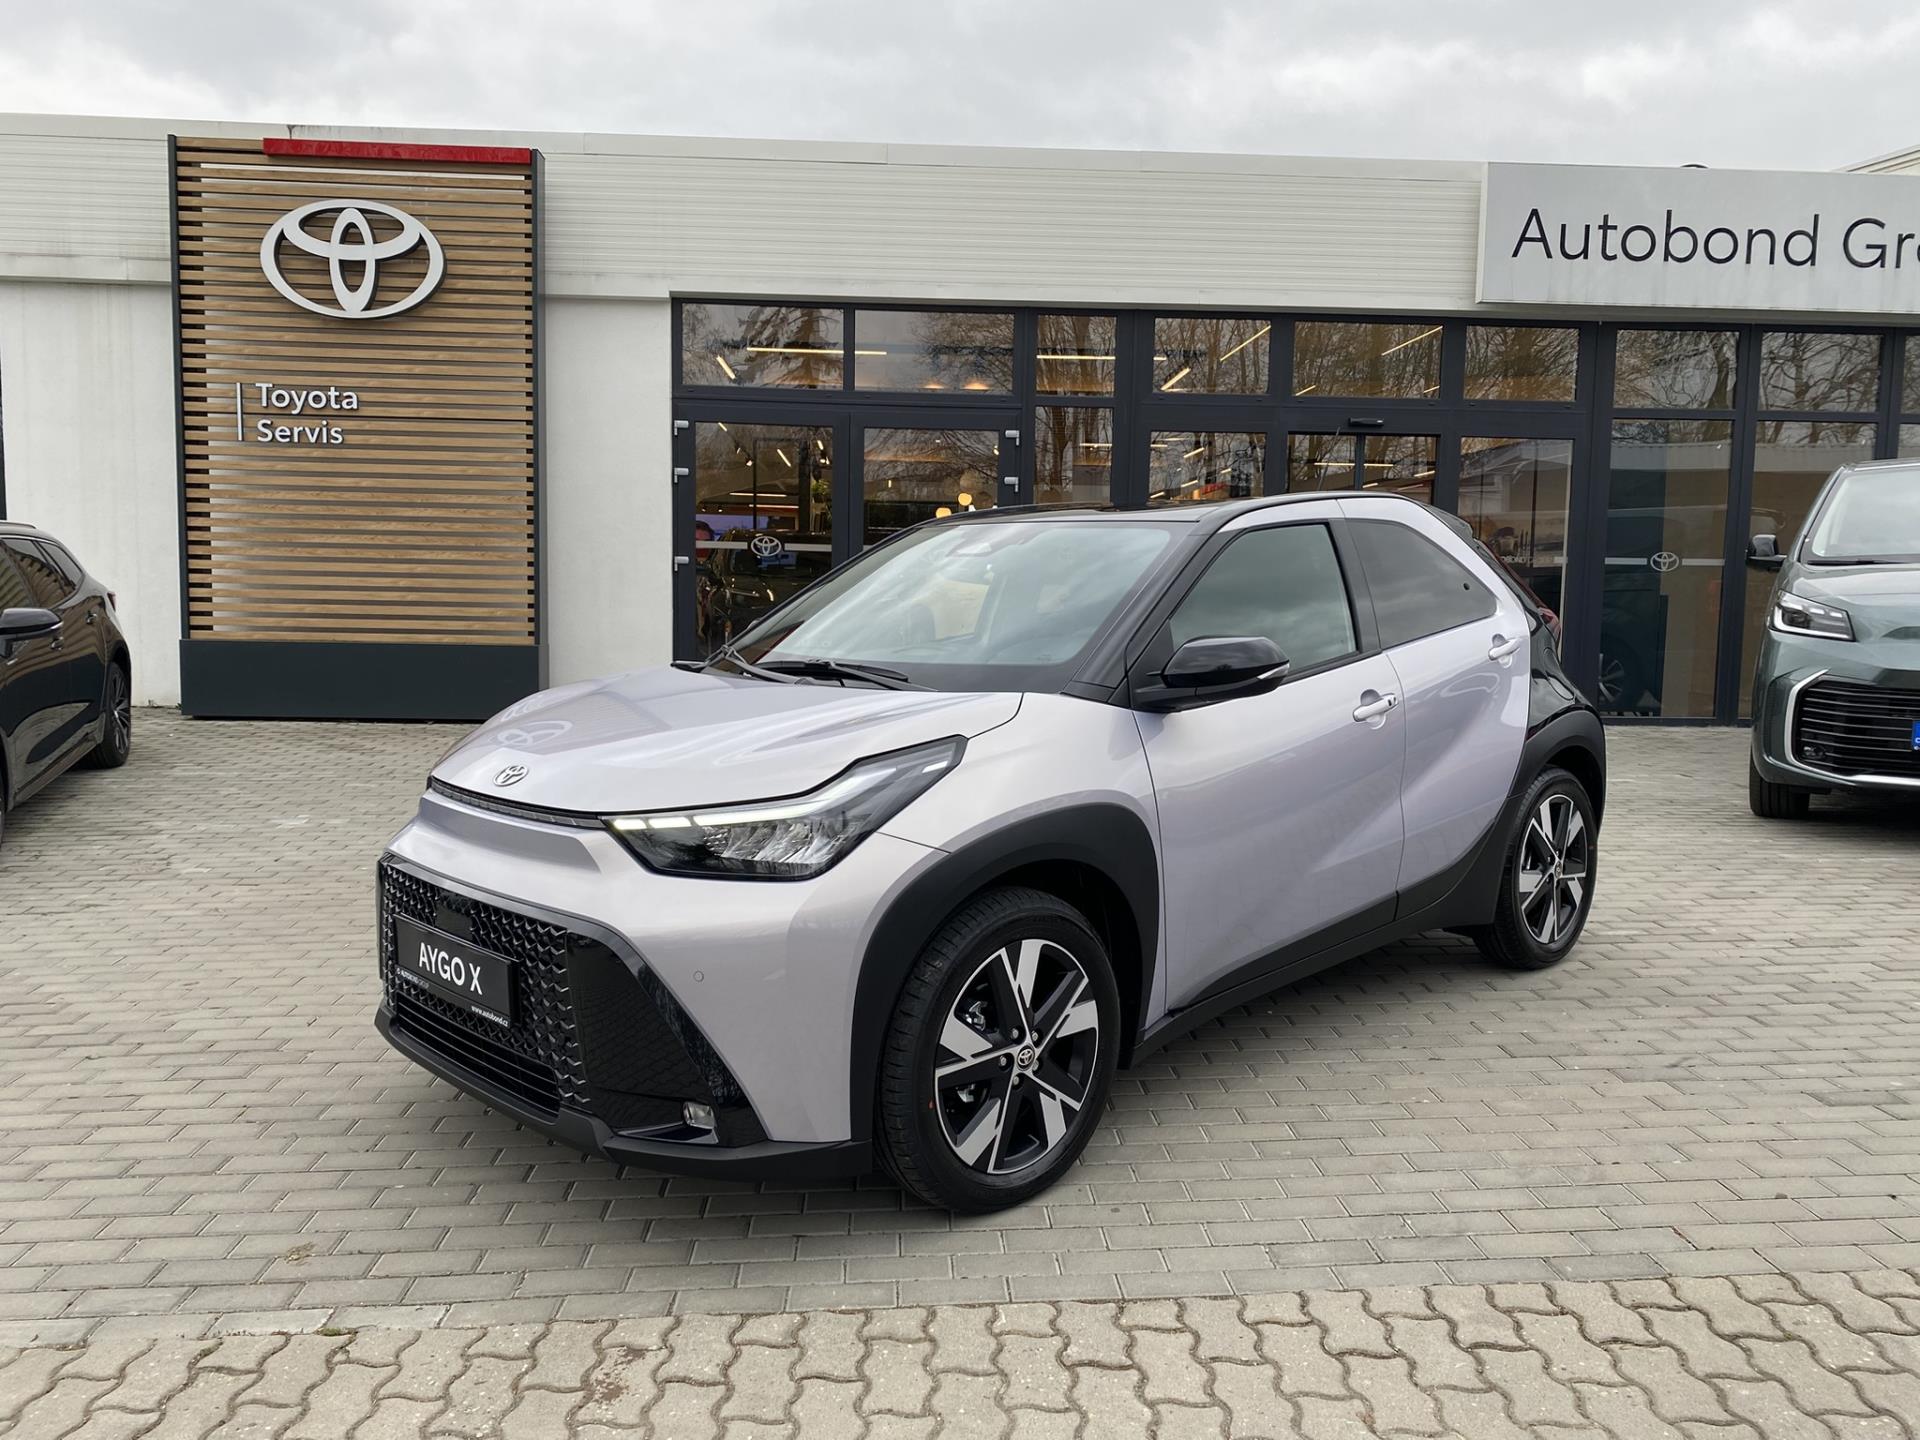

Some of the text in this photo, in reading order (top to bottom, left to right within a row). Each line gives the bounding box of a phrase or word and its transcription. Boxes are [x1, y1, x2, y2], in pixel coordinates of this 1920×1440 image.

[1511, 208, 1920, 270] Autobond Gr
[255, 382, 359, 415] Toyota
[257, 419, 344, 444] Servis
[419, 942, 466, 986] AYGO
[469, 963, 483, 995] X
